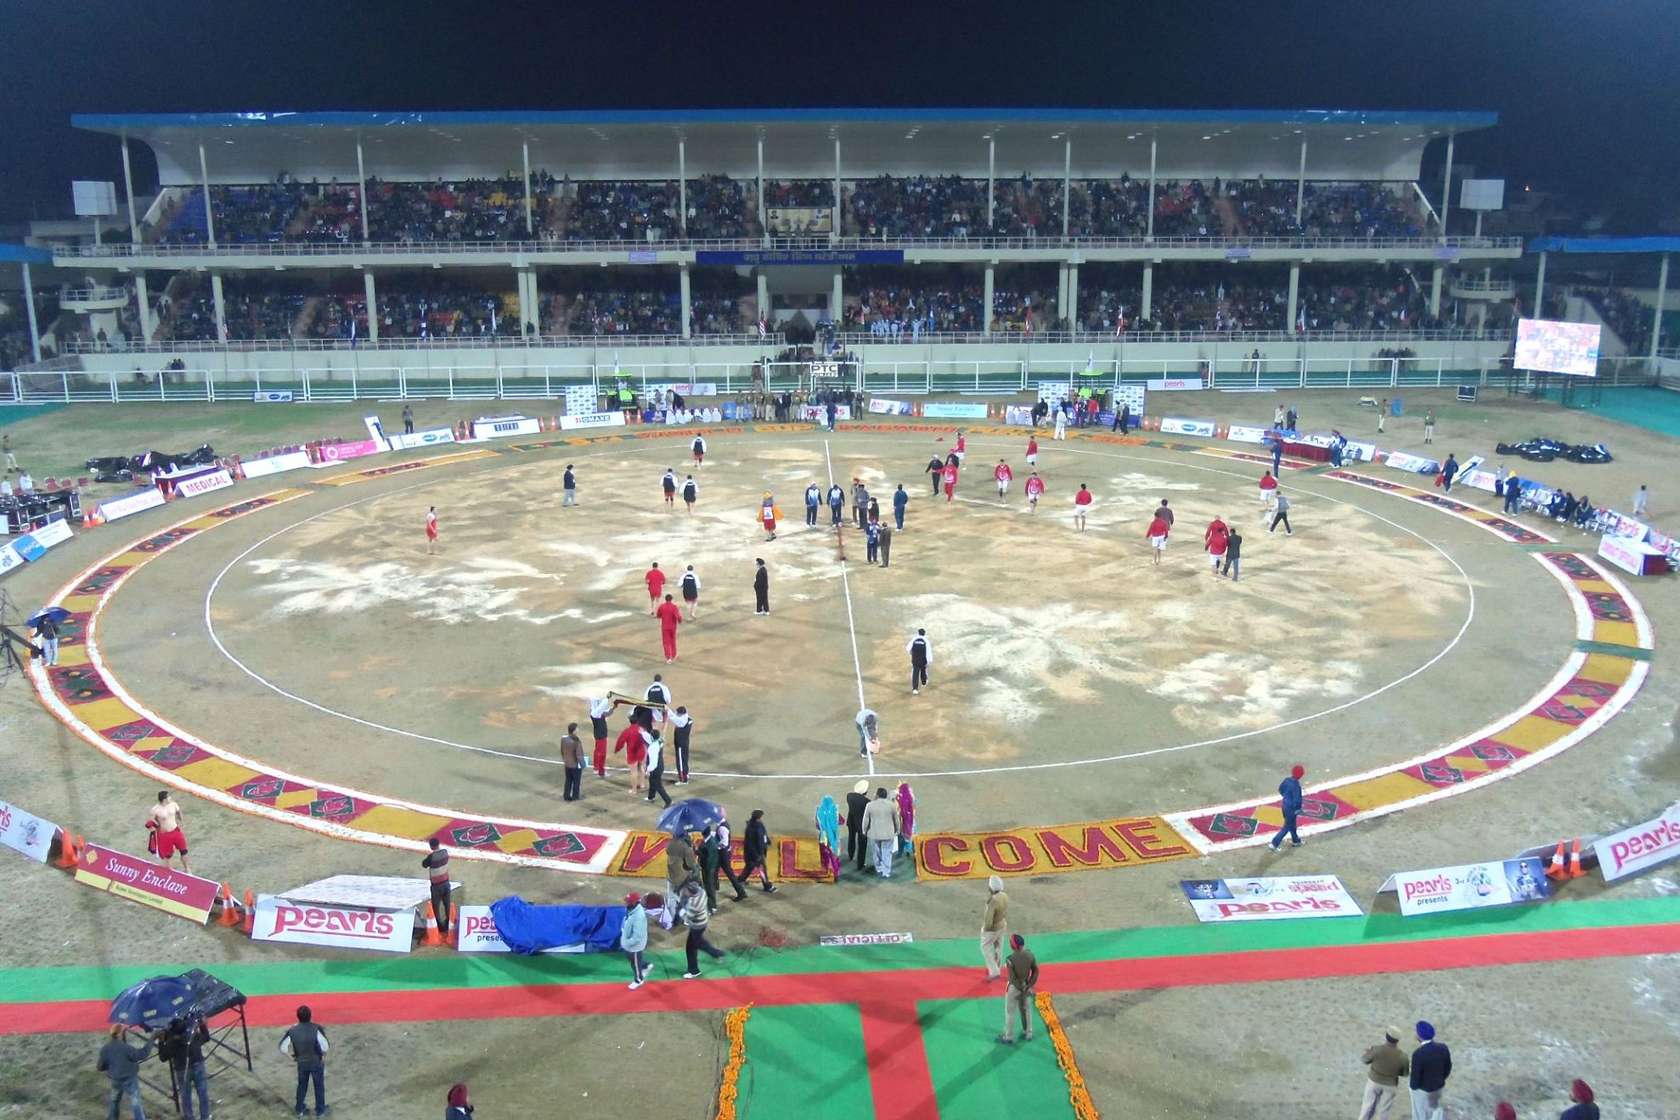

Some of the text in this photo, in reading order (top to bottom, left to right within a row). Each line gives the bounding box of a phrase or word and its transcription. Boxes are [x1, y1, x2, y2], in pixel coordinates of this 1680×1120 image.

[811, 364, 836, 373] PTC
[185, 475, 229, 493] MEDICAL
[1610, 819, 1680, 873] pearls
[105, 857, 141, 883] Sunny
[141, 869, 189, 896] Enclave
[1403, 874, 1453, 902] pearls
[1217, 896, 1341, 919] pearls
[1416, 895, 1449, 906] presents
[267, 905, 394, 938] pearls
